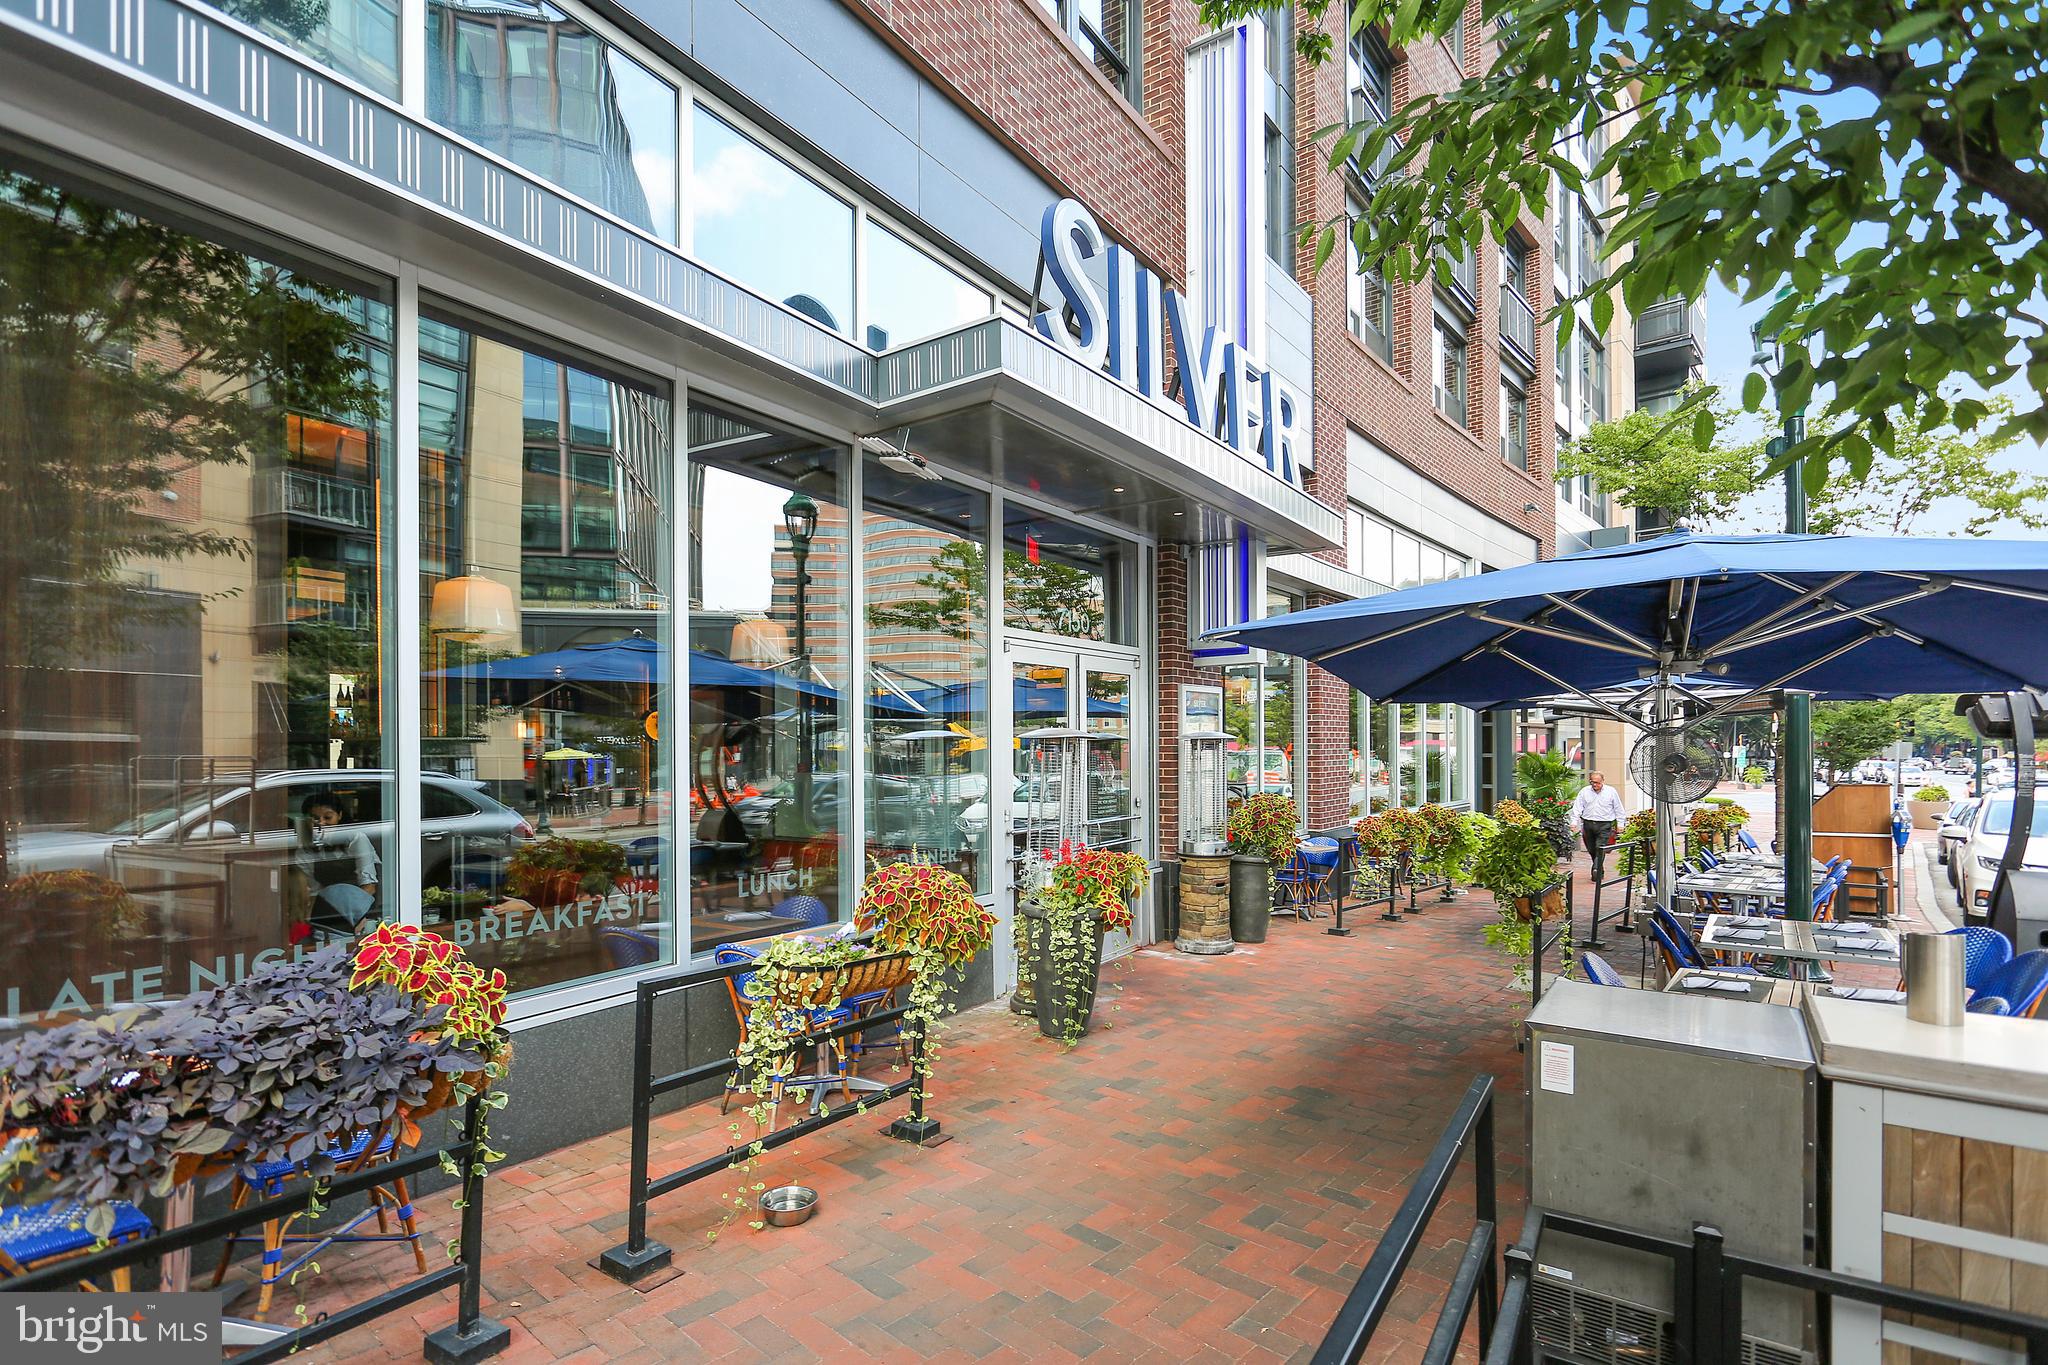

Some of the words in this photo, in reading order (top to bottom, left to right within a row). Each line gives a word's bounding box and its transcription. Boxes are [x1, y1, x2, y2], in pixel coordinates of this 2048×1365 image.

[1033, 197, 1303, 491] SILVER
[737, 867, 814, 898] LUNCH
[454, 892, 649, 947] BREAKFAST
[7, 965, 164, 1023] LATE
